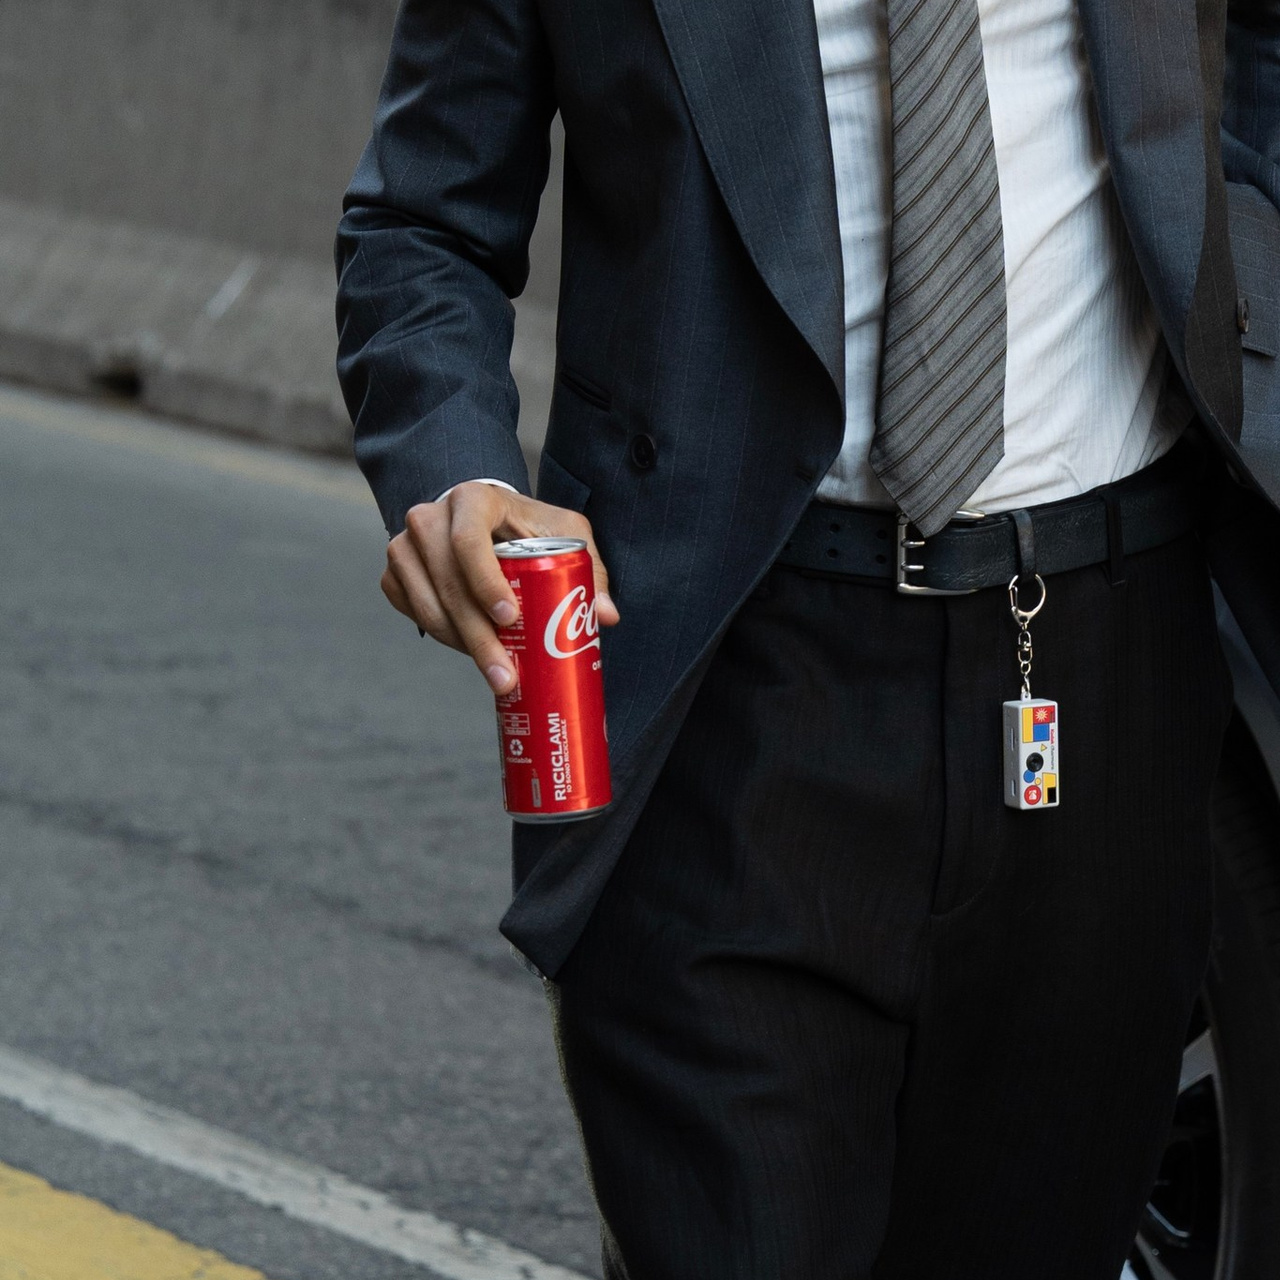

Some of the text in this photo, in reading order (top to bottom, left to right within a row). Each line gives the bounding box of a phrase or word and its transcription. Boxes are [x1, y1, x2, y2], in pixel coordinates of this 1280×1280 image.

[544, 585, 600, 659] Coc
[547, 712, 567, 801] RICICLAMI
[561, 719, 572, 793] IO SONO RICICLABILE
